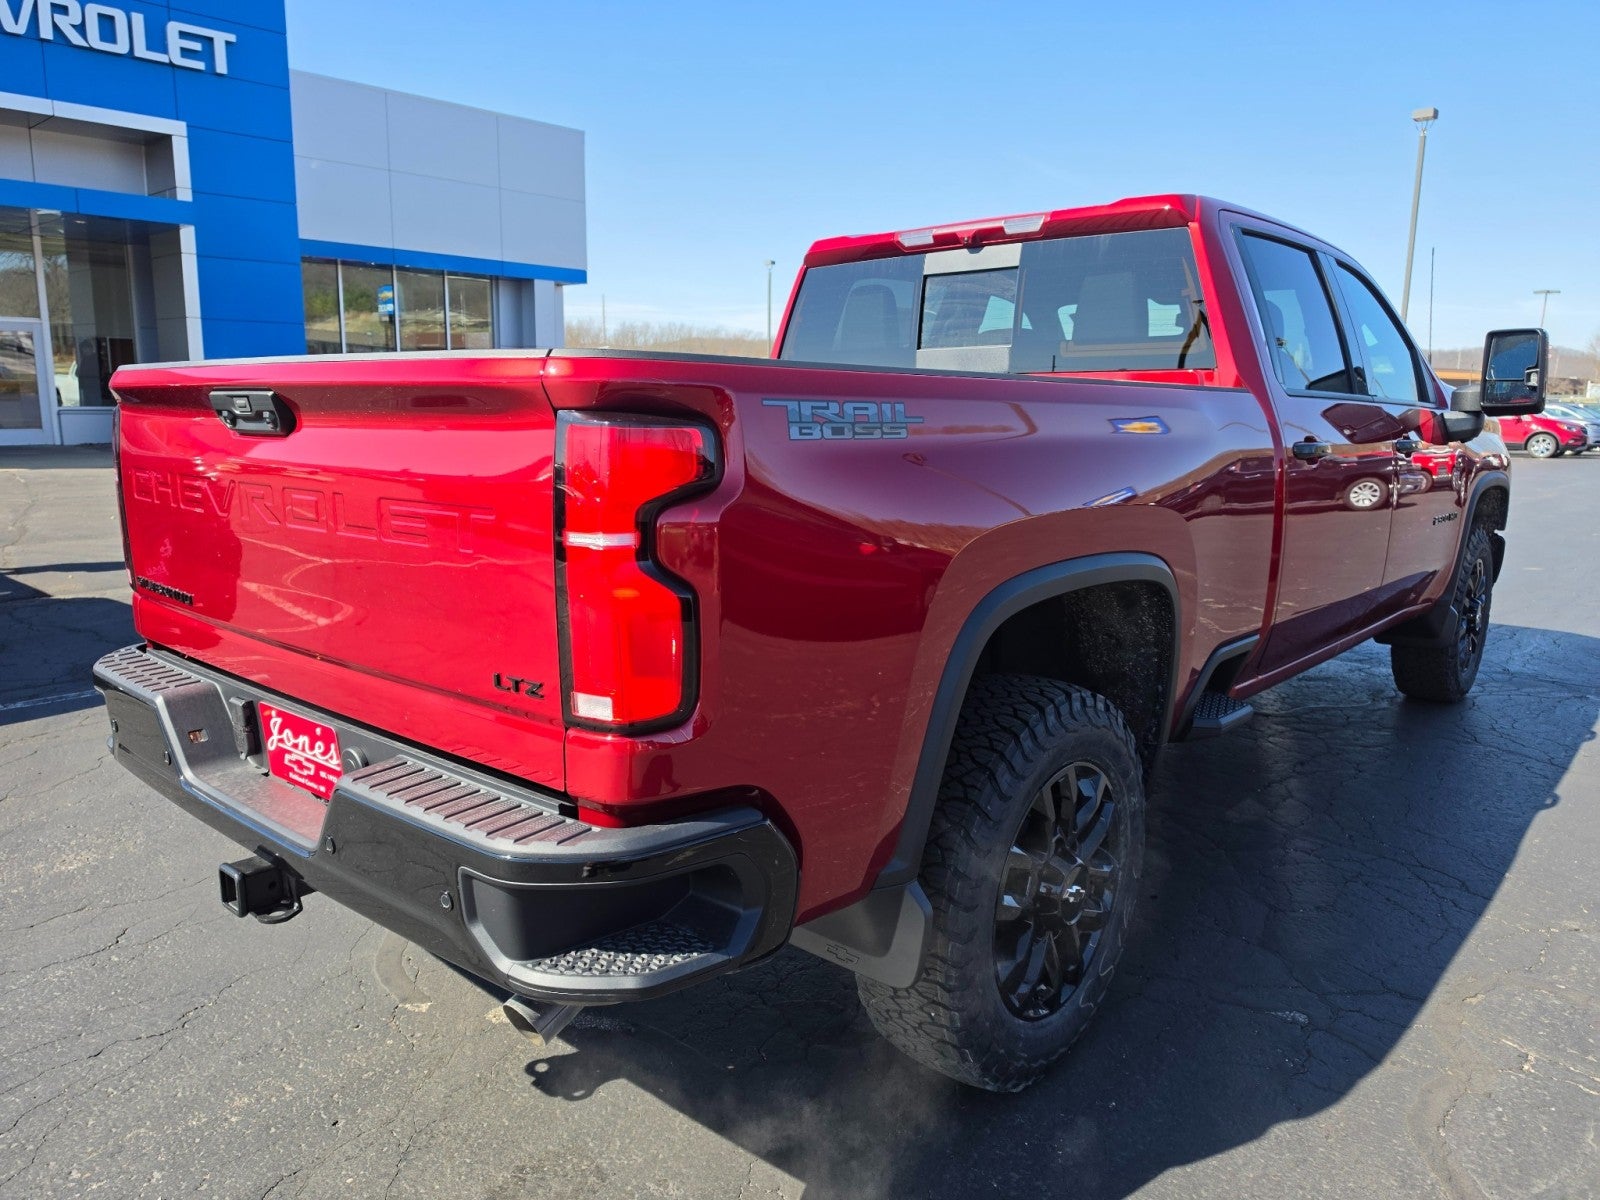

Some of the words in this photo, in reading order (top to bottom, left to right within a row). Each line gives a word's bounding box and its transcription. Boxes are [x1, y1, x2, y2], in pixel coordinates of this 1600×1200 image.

[761, 397, 925, 423] TRAIL
[788, 421, 908, 440] BOSS
[131, 468, 496, 553] CHEVROLET
[493, 672, 545, 700] LTZ
